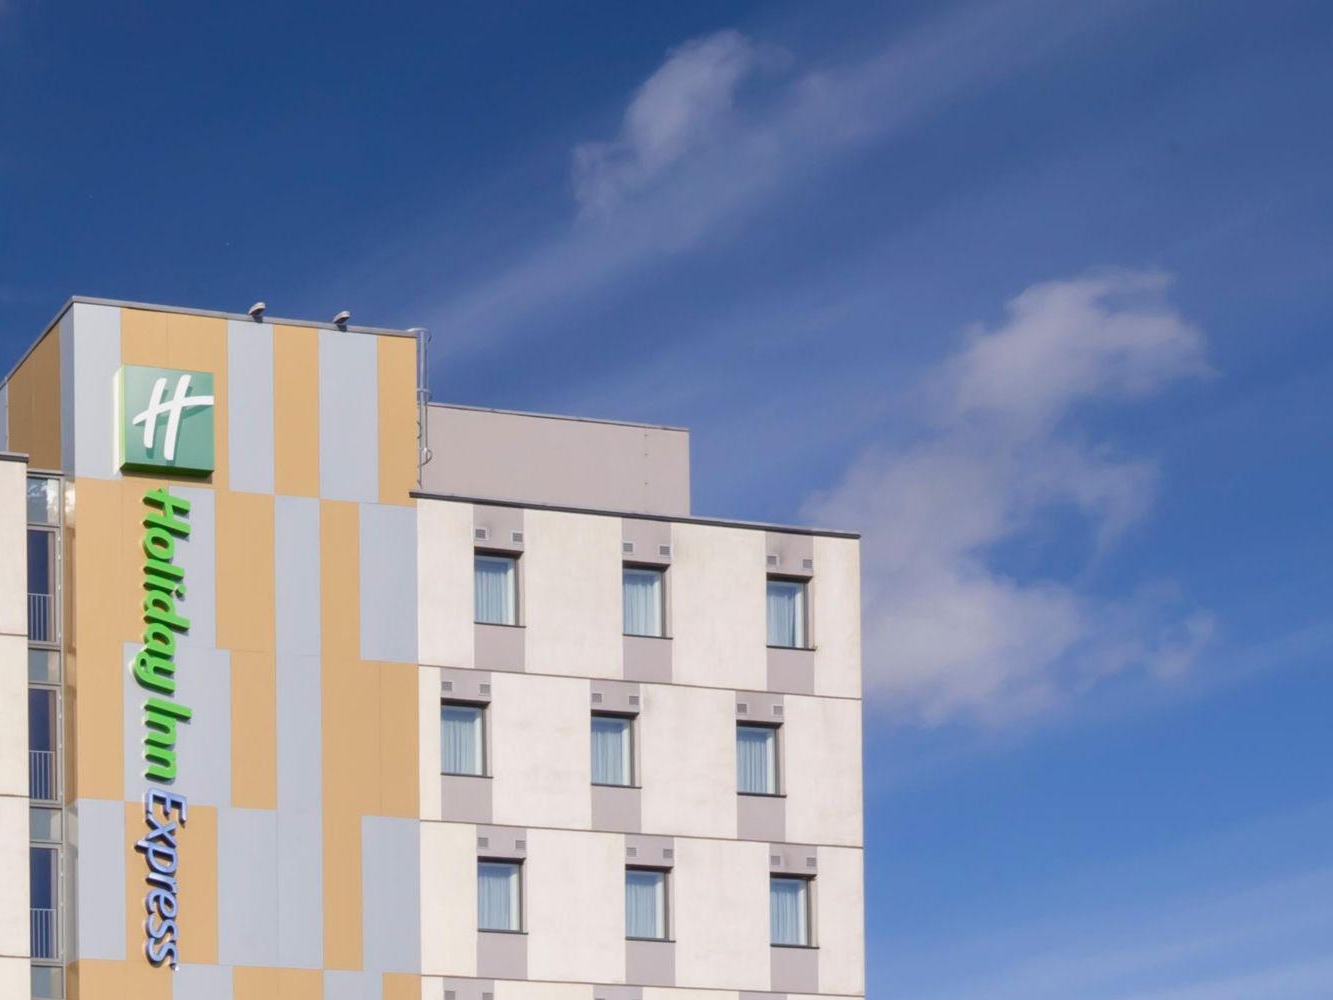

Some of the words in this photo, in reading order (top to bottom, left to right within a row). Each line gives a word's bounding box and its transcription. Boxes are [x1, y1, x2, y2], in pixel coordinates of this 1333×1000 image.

[131, 488, 191, 693] Holiday
[144, 698, 192, 782] Inn
[134, 788, 187, 967] Express
